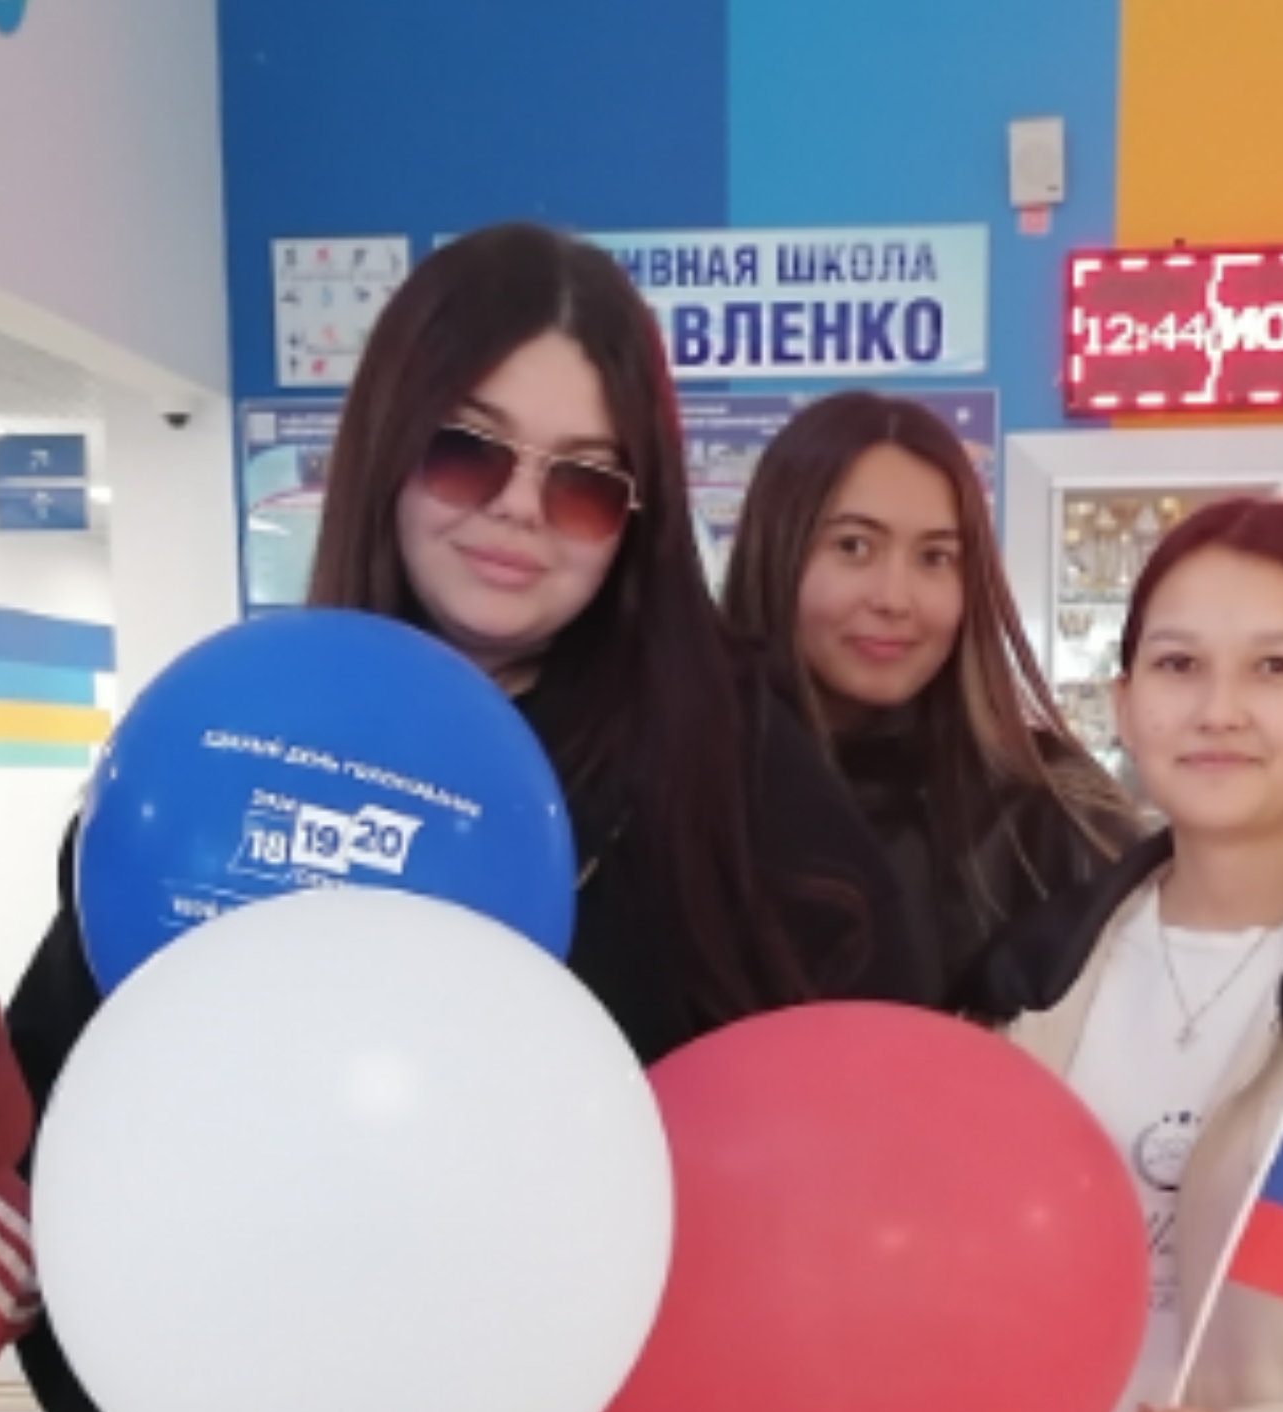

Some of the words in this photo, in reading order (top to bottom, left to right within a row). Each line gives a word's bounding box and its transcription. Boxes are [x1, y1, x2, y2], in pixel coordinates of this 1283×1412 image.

[776, 243, 938, 286] ШКОЛА
[1083, 314, 1207, 355] 12:44
[249, 830, 288, 864] 18
[301, 820, 340, 857] 19
[352, 818, 403, 858] 20
